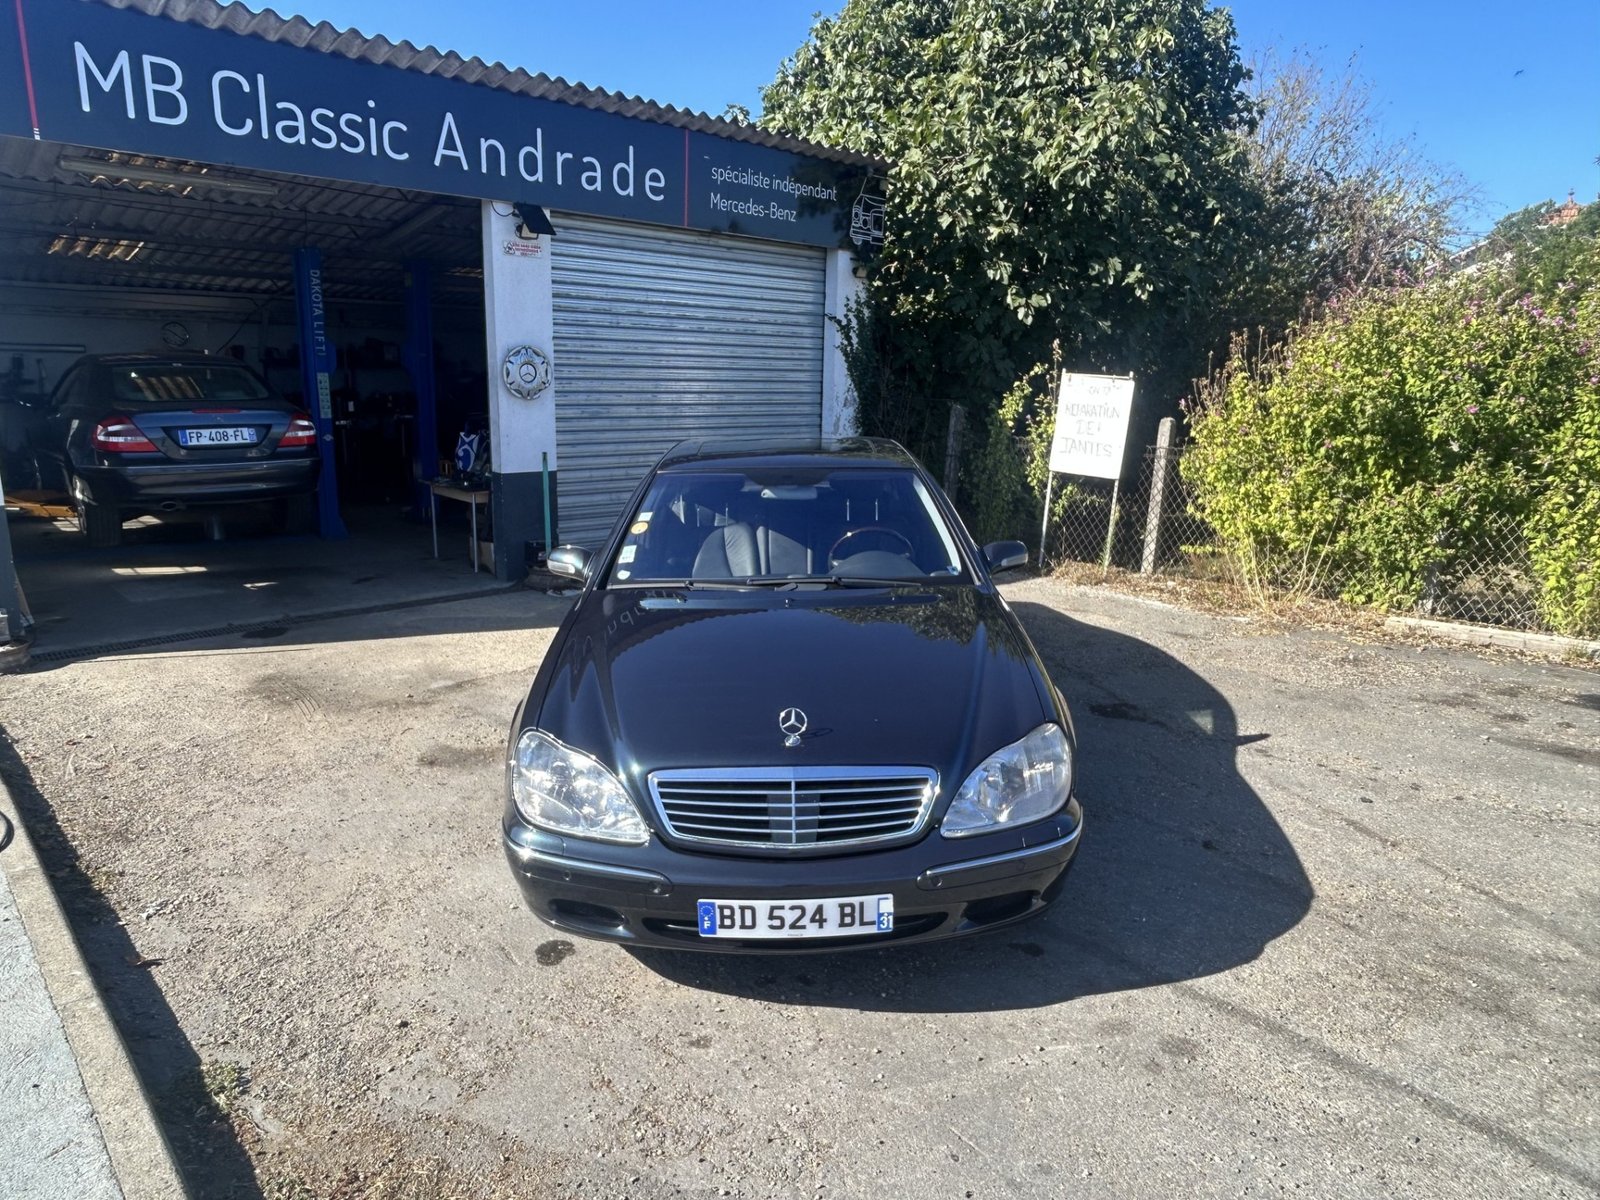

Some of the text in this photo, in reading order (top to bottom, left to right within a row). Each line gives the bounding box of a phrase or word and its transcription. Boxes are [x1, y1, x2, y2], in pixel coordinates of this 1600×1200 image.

[72, 40, 667, 202] MB Classic Andrade
[711, 165, 838, 202] spécialiste indépendant
[710, 192, 797, 223] Mercedes-Benz
[310, 269, 324, 316] DAKOTA
[717, 904, 757, 930] BD
[767, 904, 828, 930] 524
[838, 901, 877, 928] BL
[880, 914, 894, 928] 31
